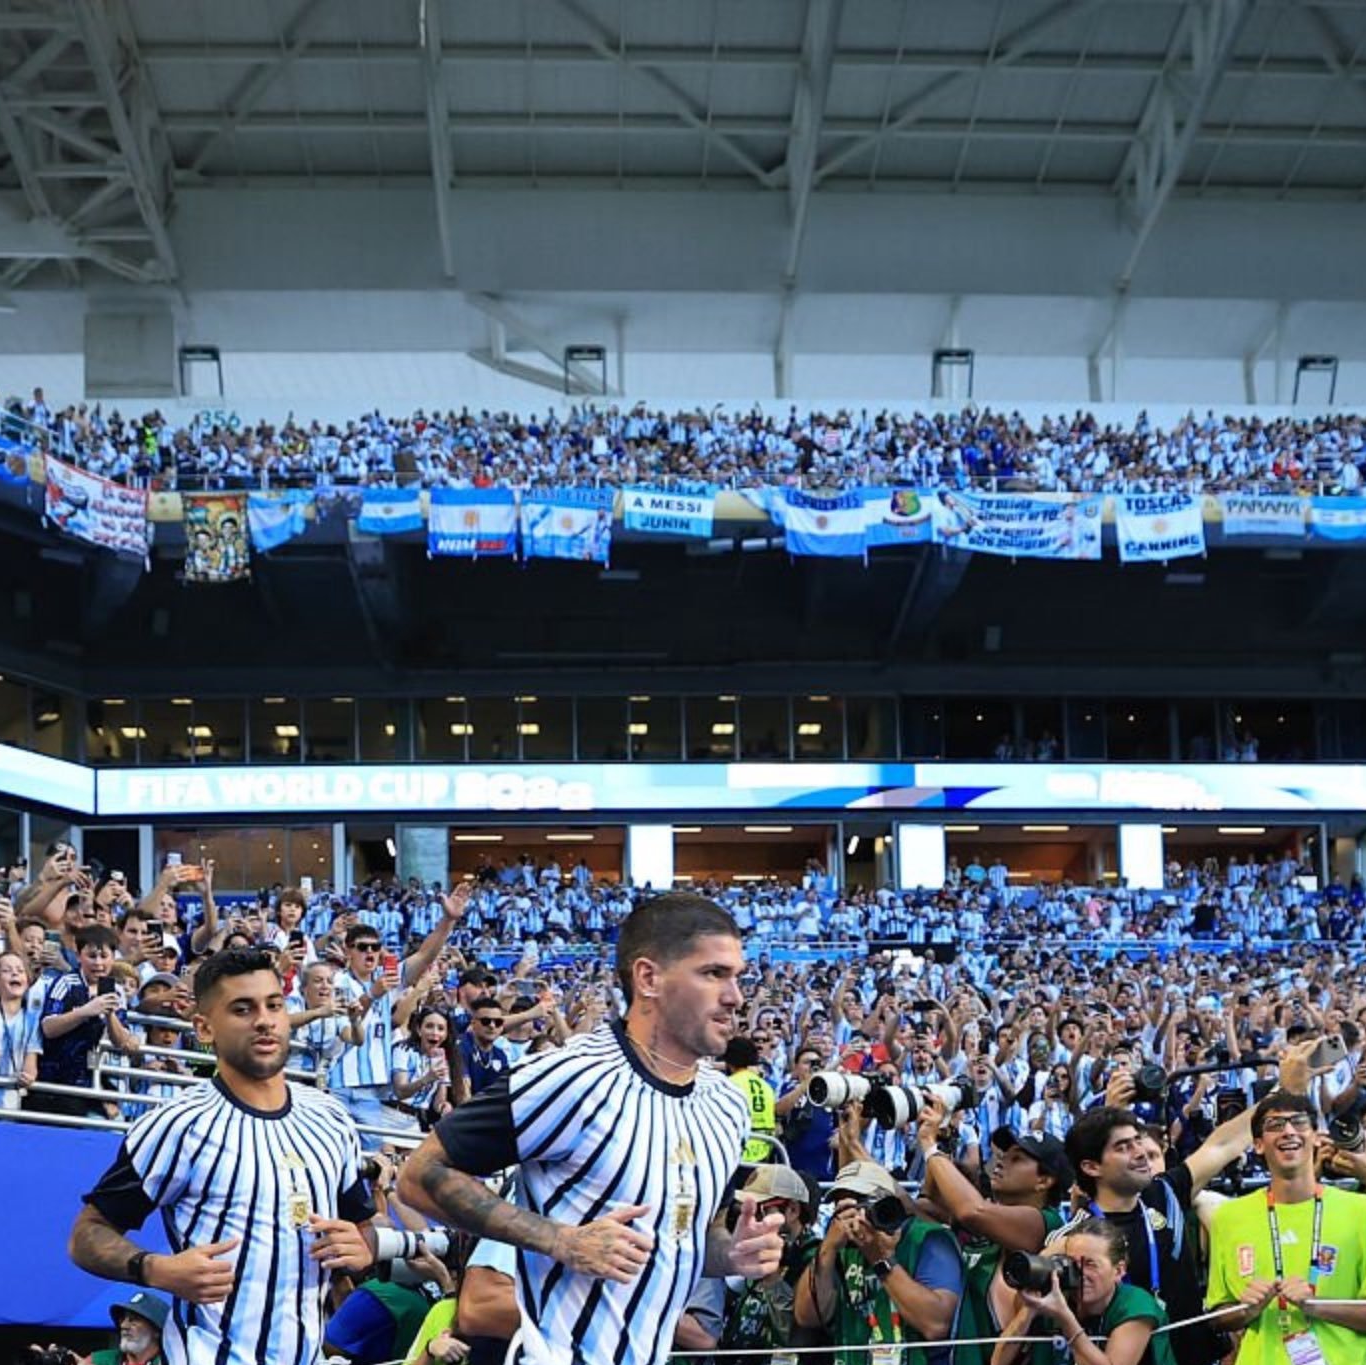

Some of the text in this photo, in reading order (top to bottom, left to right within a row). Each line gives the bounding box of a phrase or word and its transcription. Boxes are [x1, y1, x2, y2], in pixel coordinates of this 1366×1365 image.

[633, 497, 702, 513] A MESSI
[128, 776, 212, 807] FIFA
[217, 773, 364, 807] WORLD
[368, 773, 452, 809] CUP
